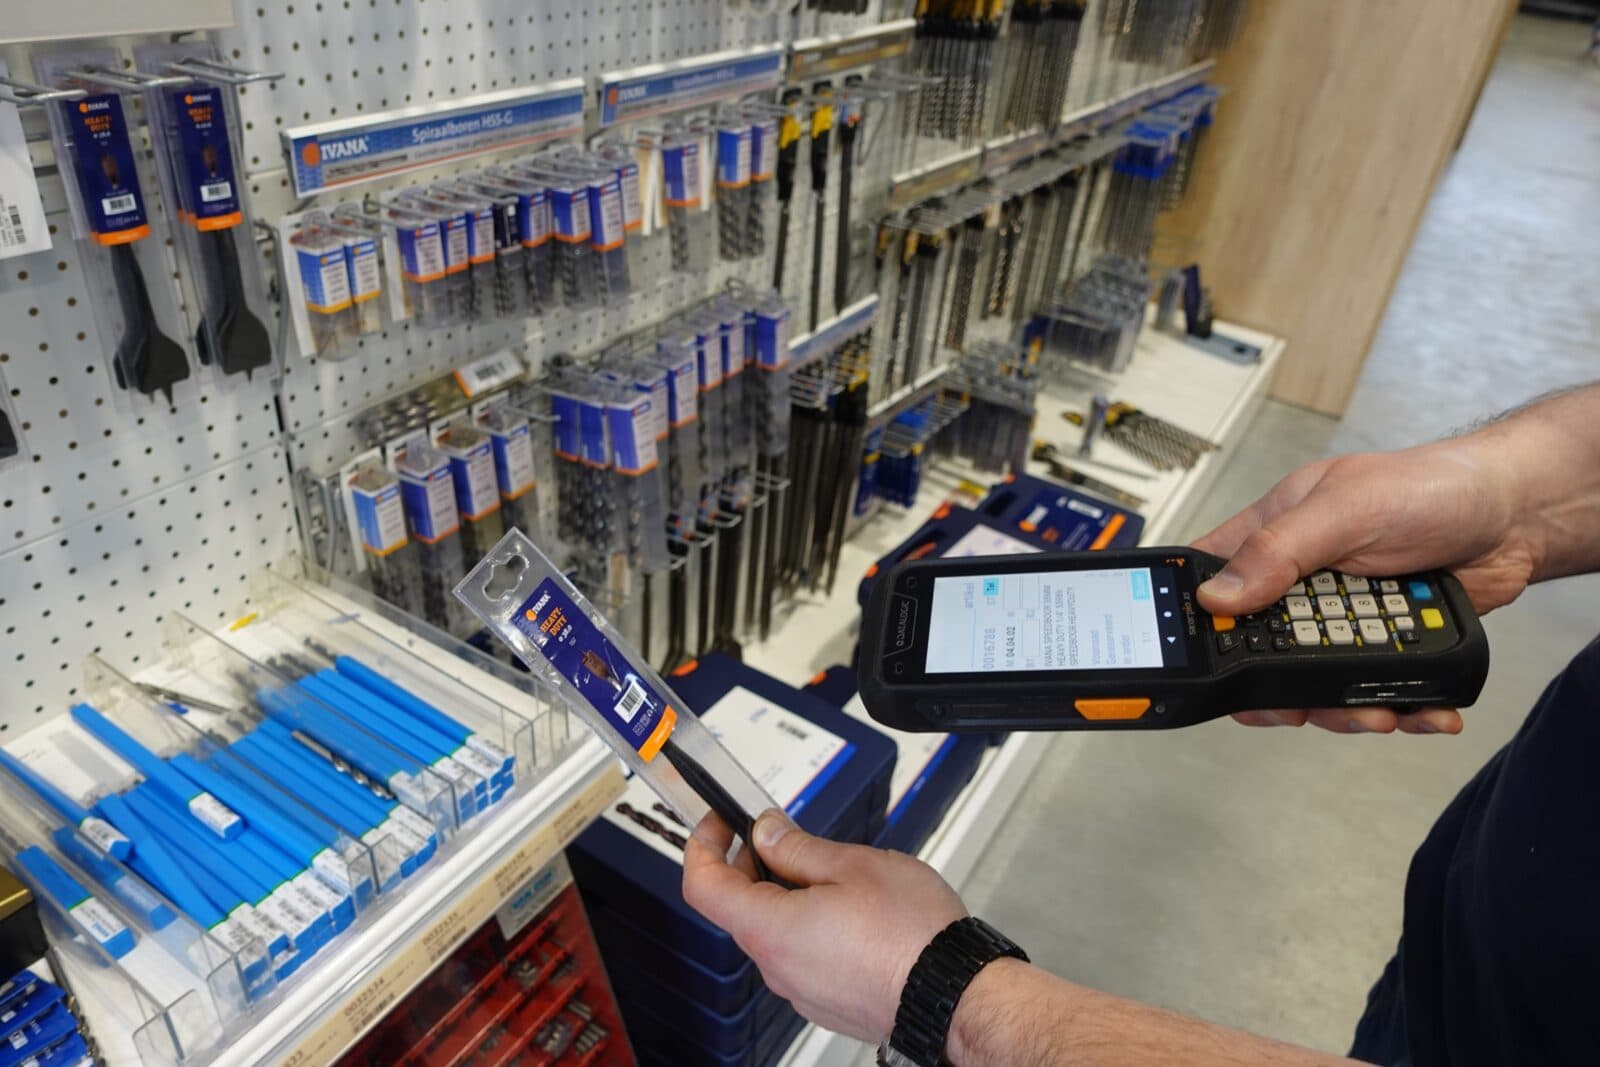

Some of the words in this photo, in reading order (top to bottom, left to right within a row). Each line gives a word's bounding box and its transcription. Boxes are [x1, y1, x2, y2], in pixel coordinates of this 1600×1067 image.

[411, 118, 481, 145] Spiraalboren
[320, 139, 368, 161] IVANA
[550, 614, 567, 637] DUTY
[1006, 626, 1016, 658] 04.04.02
